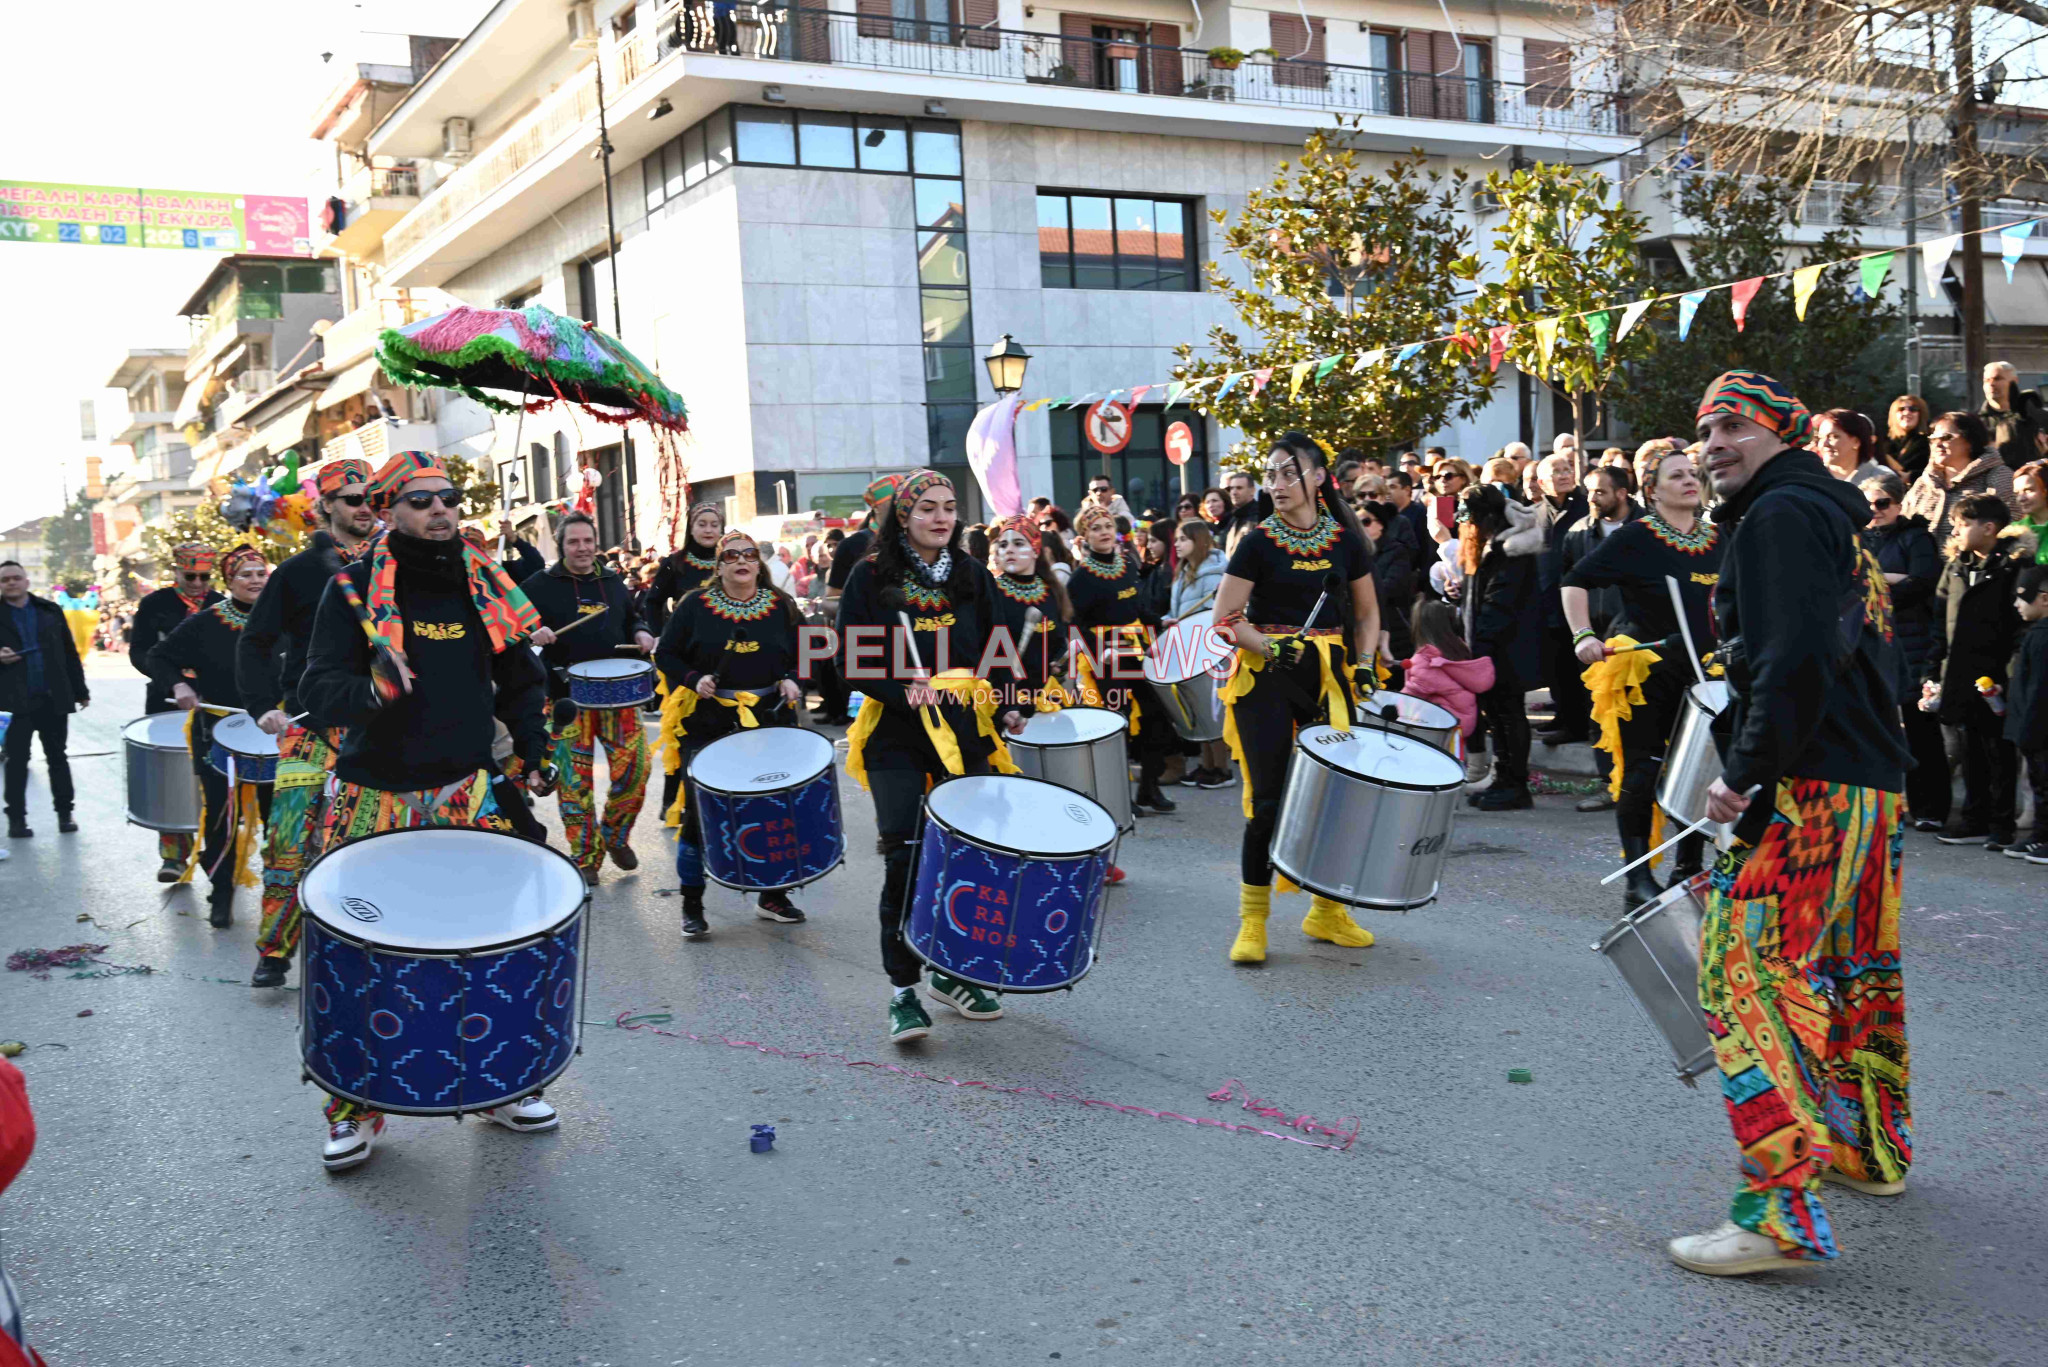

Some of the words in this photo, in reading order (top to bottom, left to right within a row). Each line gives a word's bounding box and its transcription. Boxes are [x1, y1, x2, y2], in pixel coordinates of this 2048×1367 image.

[84, 191, 231, 212] ΚΑΡΝΑΒΑΛΙΚΗ
[113, 208, 152, 225] ΣΤΗ
[158, 211, 233, 229] ΣΚΥΔΡΑ
[59, 225, 80, 241] 22
[144, 229, 198, 248] 2026
[764, 818, 796, 832] KA
[766, 834, 798, 848] RA
[769, 843, 812, 863] NOS
[977, 885, 1009, 905] KA
[974, 905, 1005, 926] RA
[970, 926, 1018, 948] NOS
